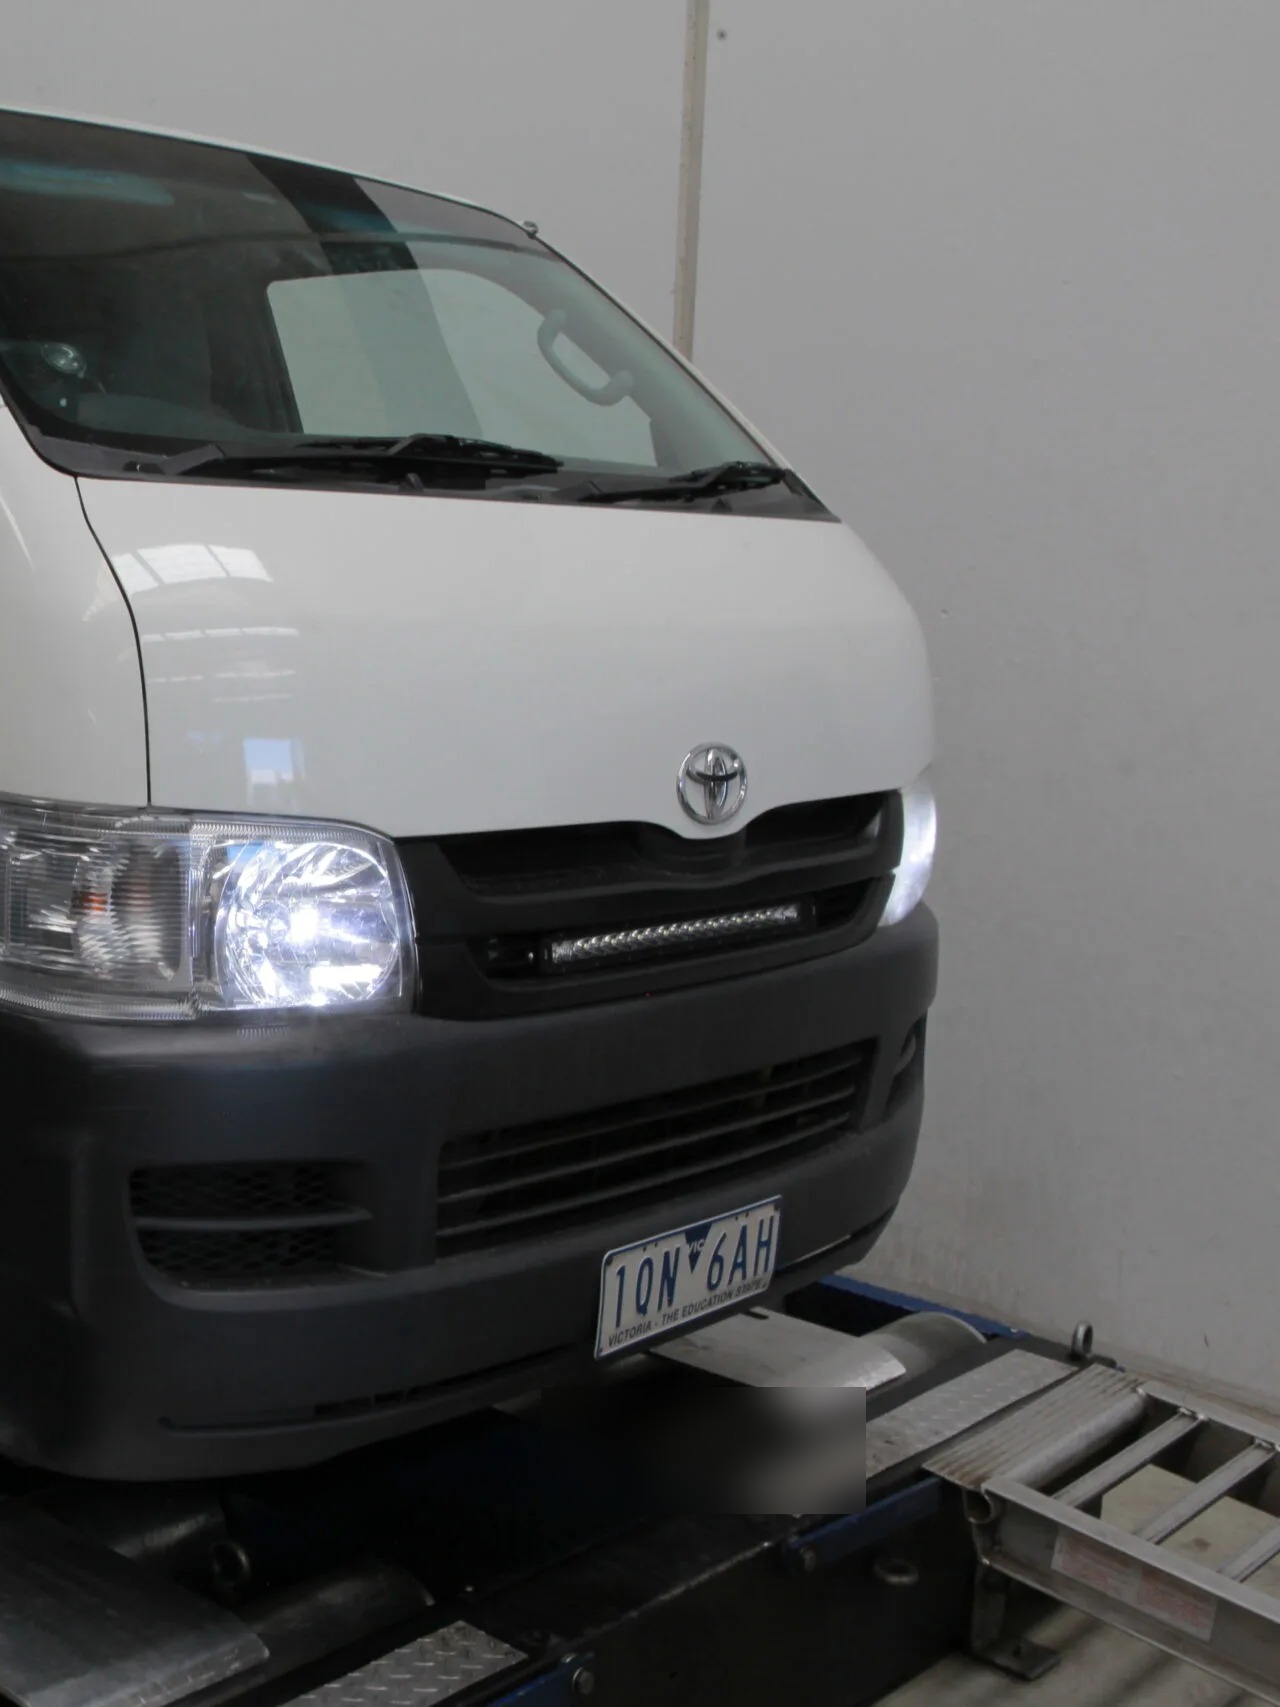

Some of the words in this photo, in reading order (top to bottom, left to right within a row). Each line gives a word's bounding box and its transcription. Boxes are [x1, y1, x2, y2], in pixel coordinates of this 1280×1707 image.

[707, 1215, 774, 1291] 6AH
[608, 1319, 651, 1347] VICTORIA
[662, 1309, 680, 1325] THE
[682, 1291, 733, 1317] EDUCATION
